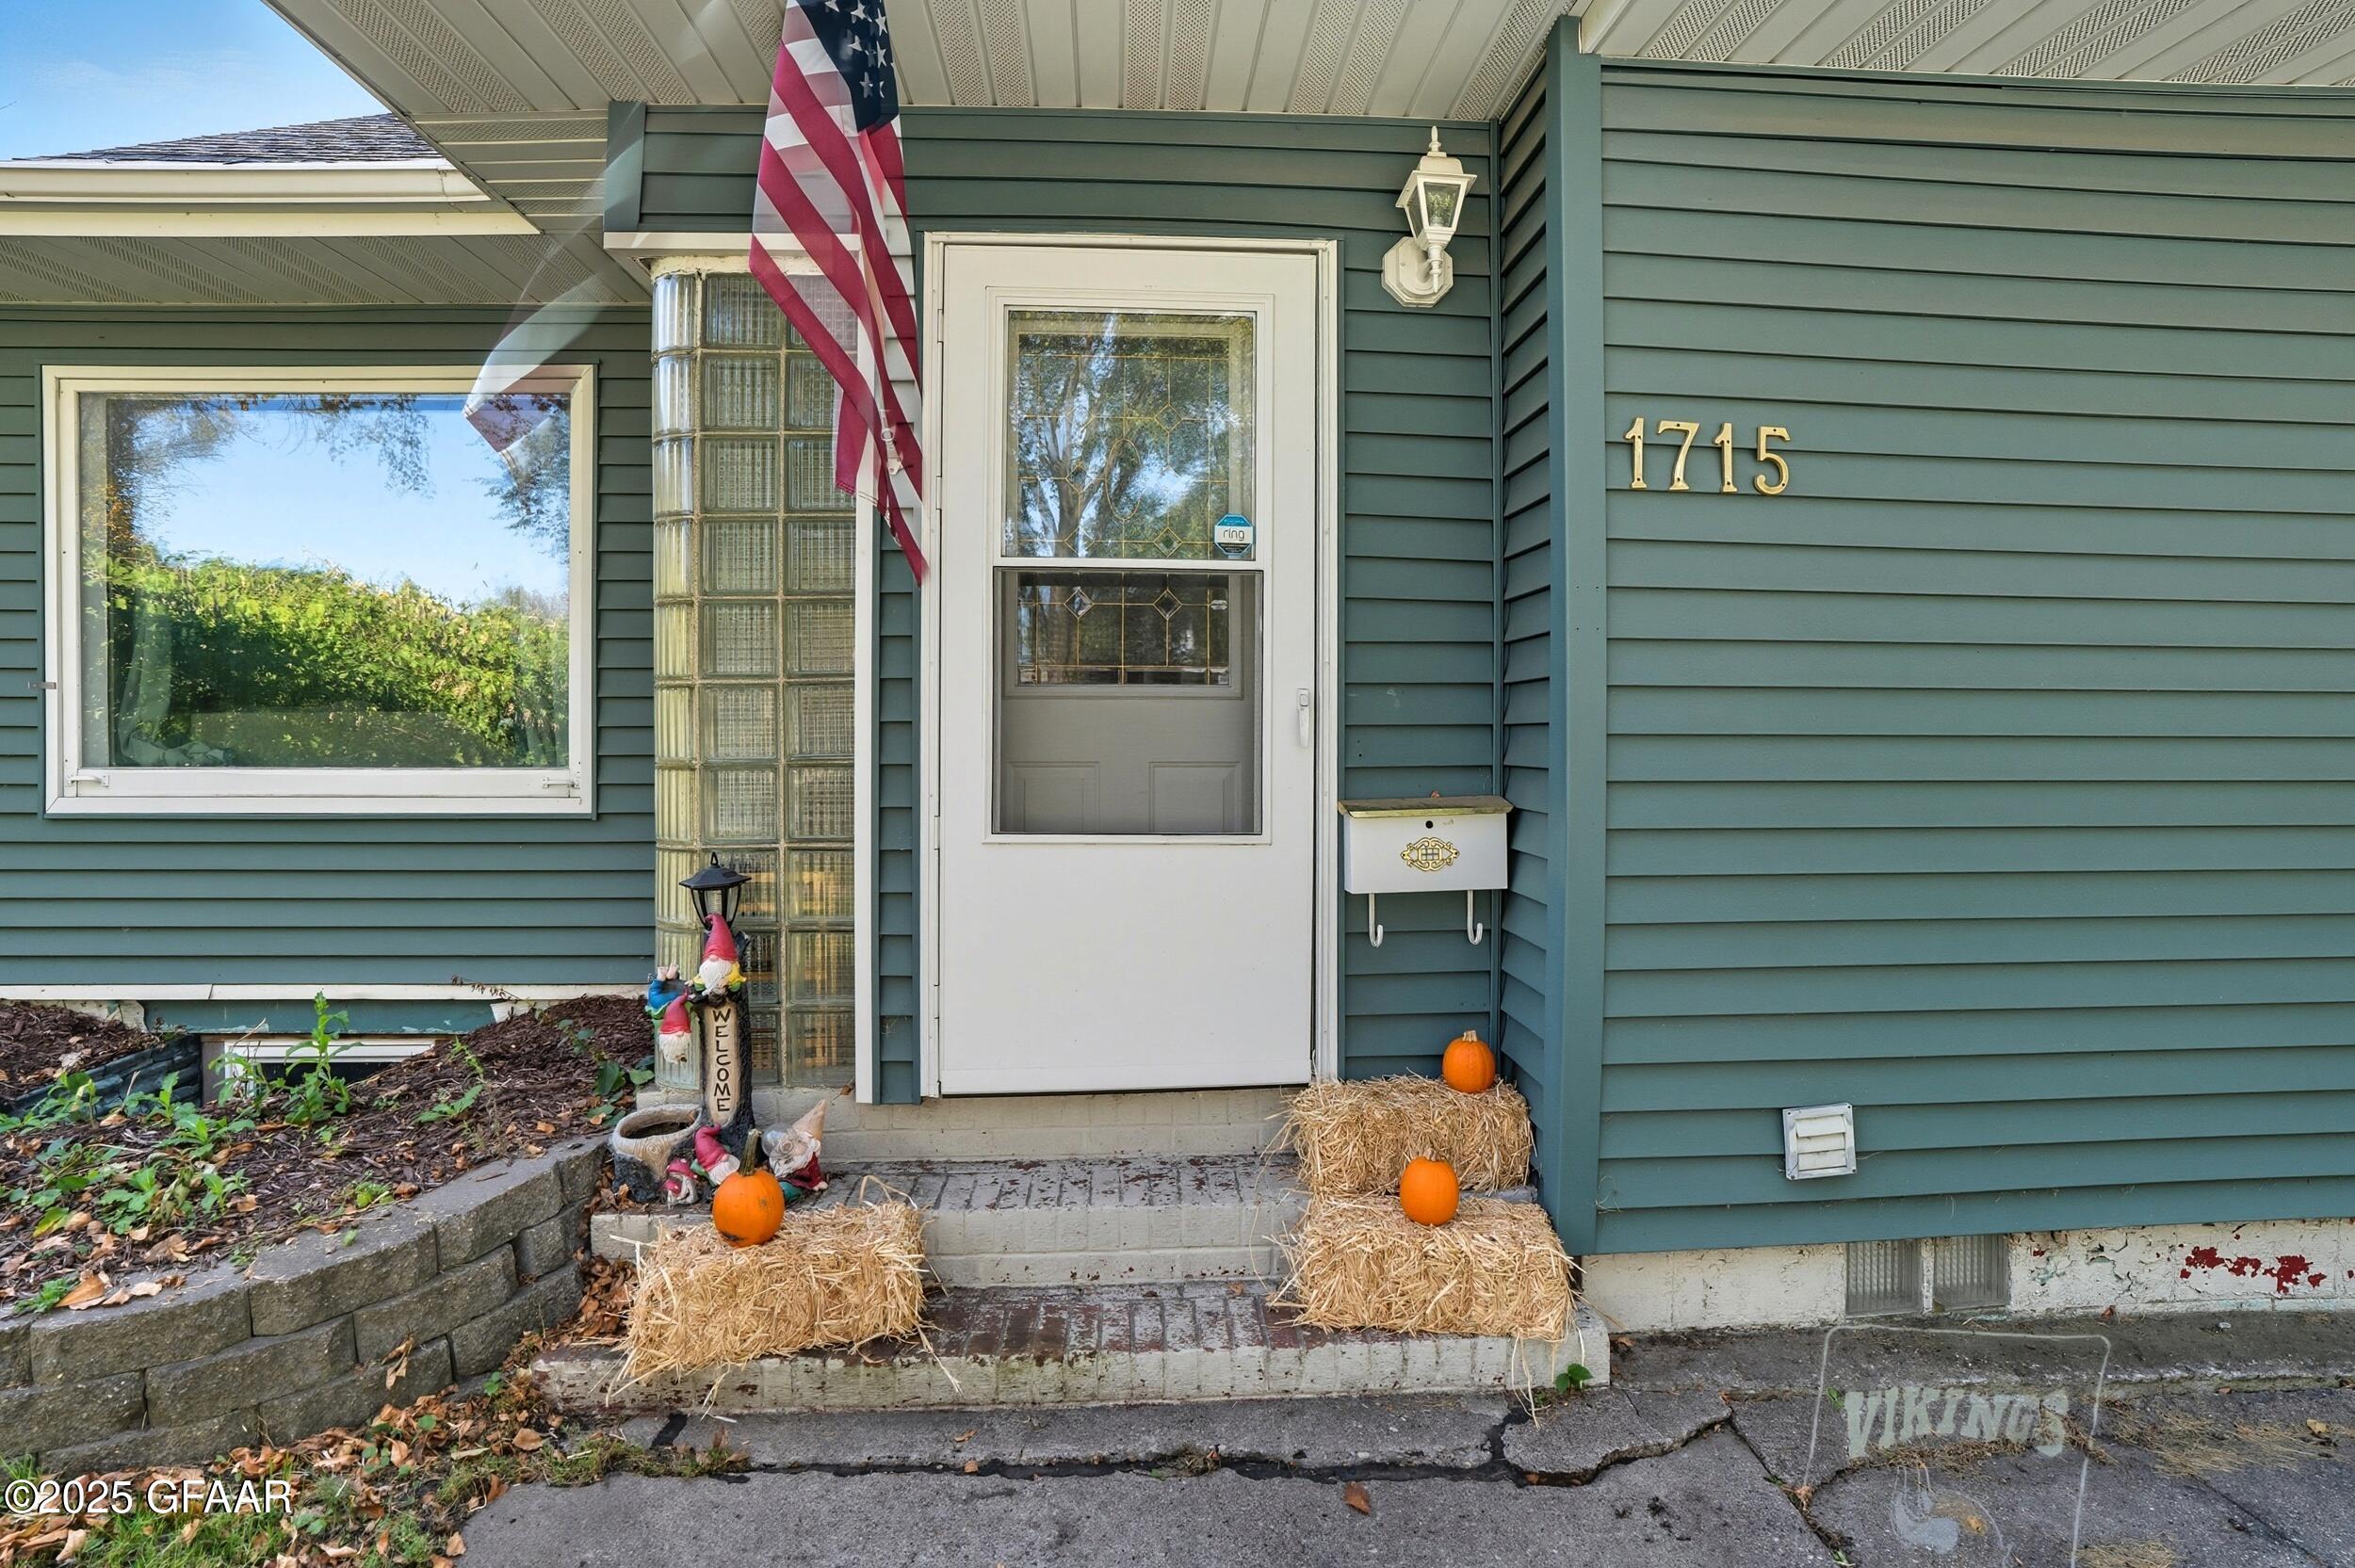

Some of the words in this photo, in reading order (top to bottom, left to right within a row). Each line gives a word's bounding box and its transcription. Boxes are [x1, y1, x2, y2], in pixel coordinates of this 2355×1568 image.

[1624, 417, 1791, 495] 1715
[1223, 528, 1245, 542] ring
[712, 1008, 732, 1112] WELCOME
[1843, 1385, 2070, 1461] VIKINGS
